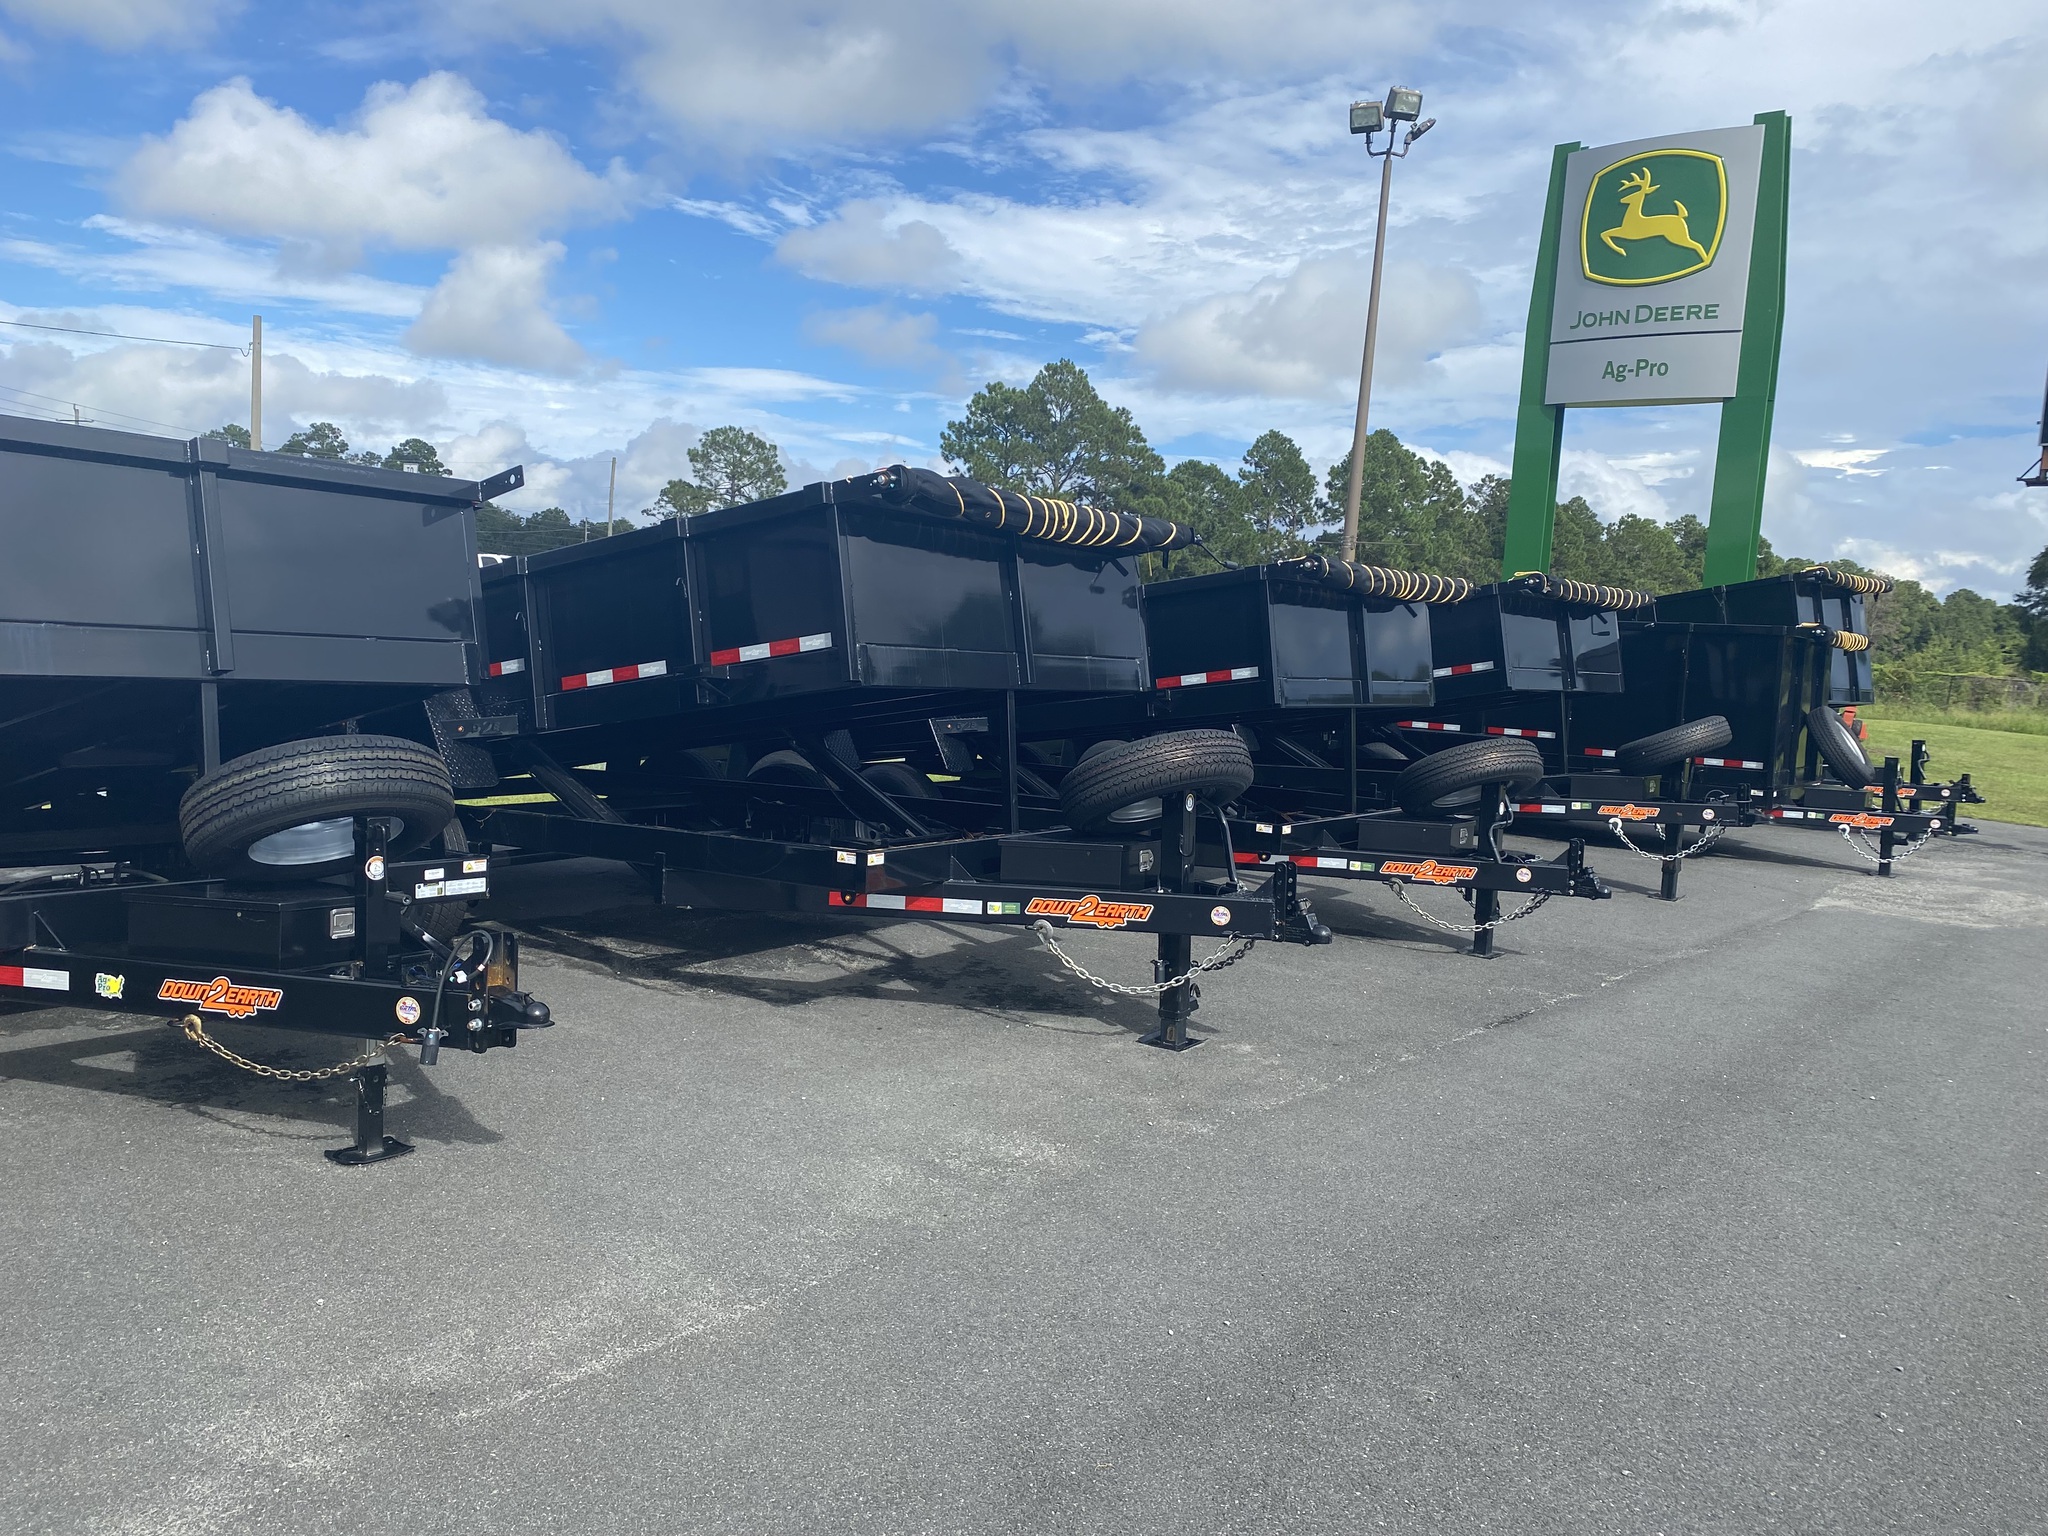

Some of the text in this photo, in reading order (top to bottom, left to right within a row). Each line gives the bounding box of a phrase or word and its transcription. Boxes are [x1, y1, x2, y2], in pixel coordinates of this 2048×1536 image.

[1570, 303, 1720, 329] JOHN DEERE
[1602, 358, 1669, 382] Ag-Pro
[1382, 861, 1476, 882] DOWN2EARTH
[1028, 896, 1152, 924] DOWN2EARTH
[160, 978, 281, 1014] DOWN2EARTH
